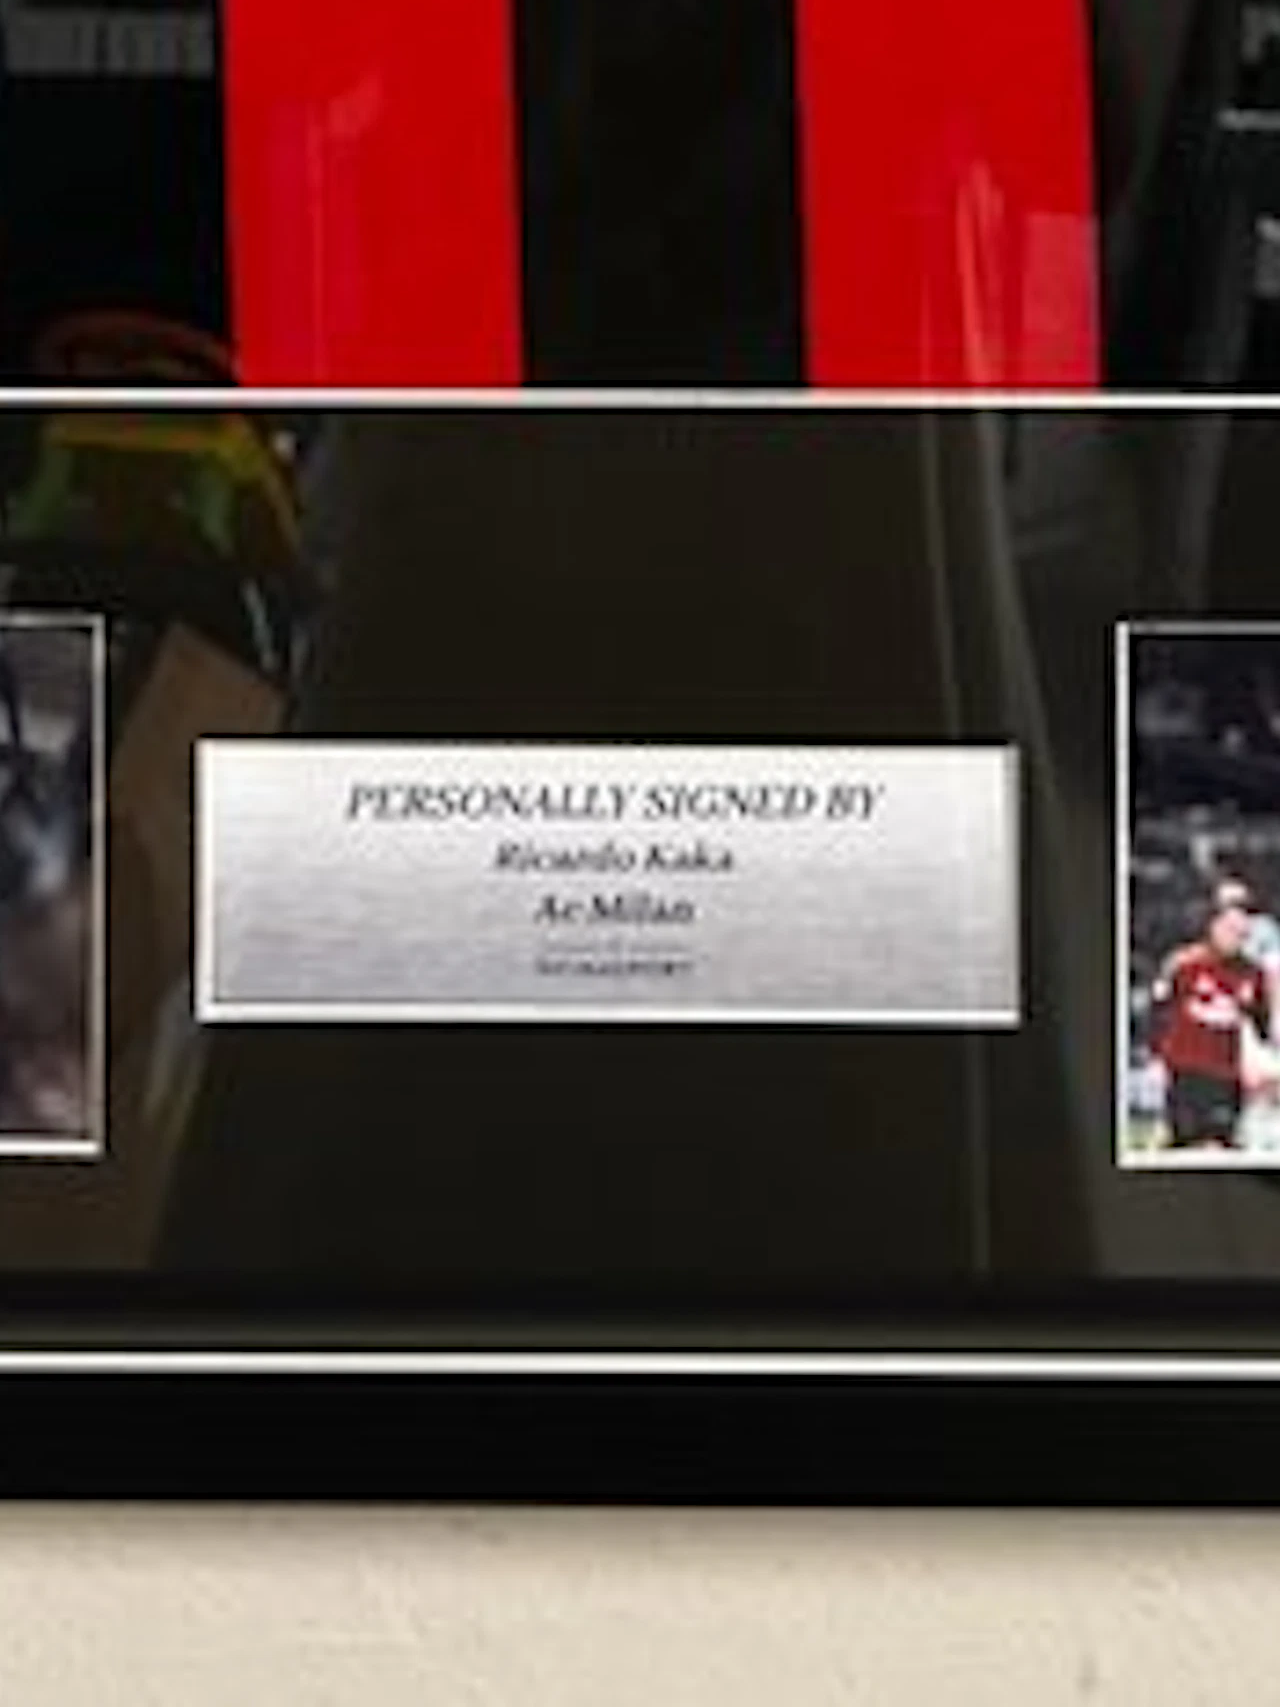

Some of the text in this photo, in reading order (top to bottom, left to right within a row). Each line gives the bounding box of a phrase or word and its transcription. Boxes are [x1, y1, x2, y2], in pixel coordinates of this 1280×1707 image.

[346, 782, 888, 823] PERSONALLY SIGNED BY
[491, 838, 736, 875] Ricardo Kaka
[586, 889, 697, 926] Milan
